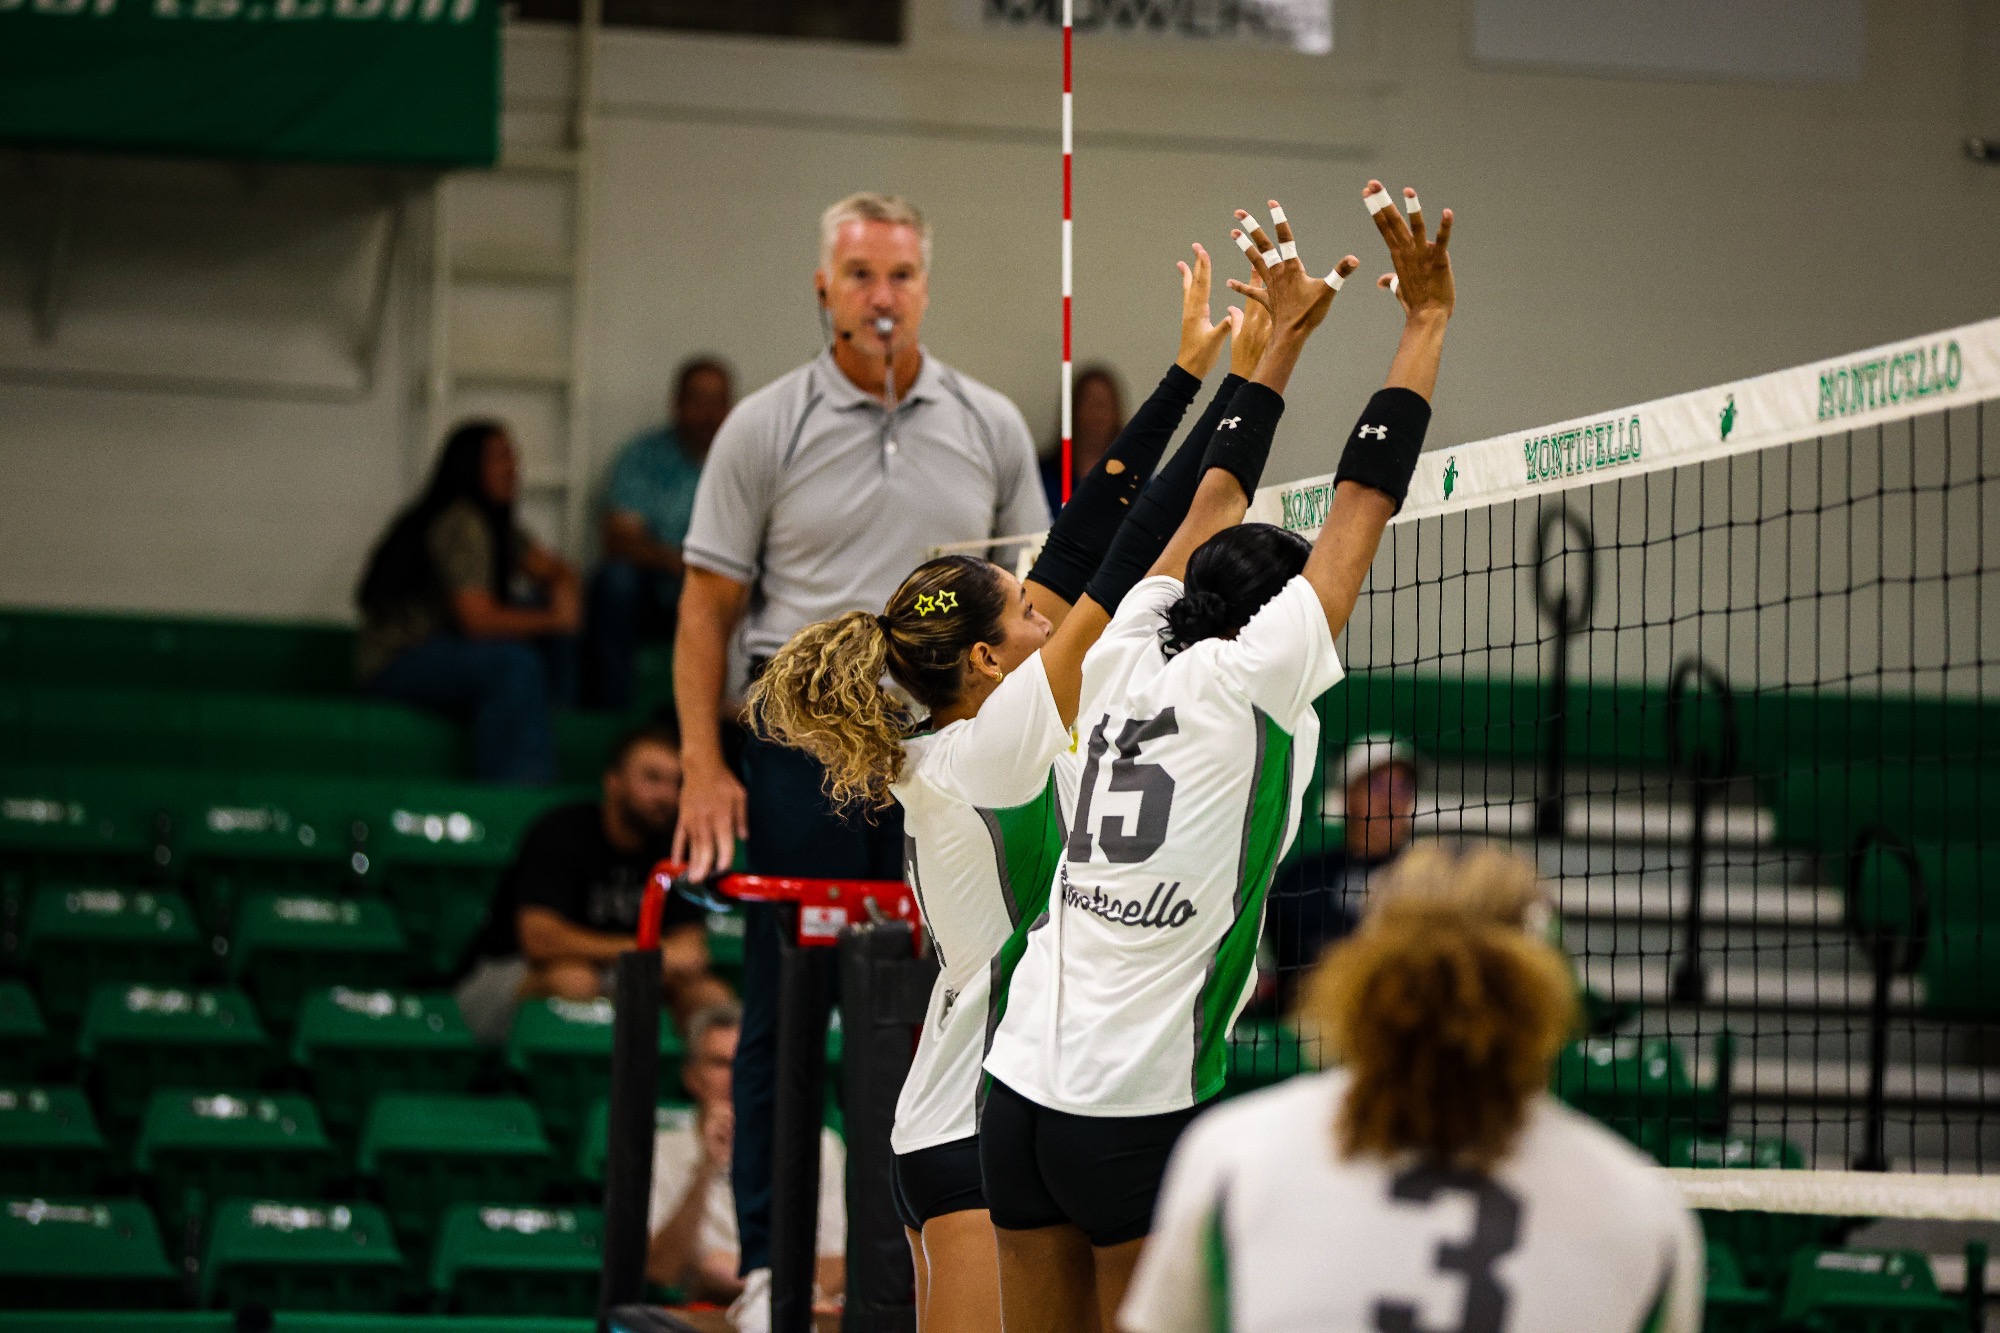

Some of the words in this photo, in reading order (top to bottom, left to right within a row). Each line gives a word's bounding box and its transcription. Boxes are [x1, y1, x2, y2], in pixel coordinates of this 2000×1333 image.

[1818, 339, 1962, 421] MONTICELLO
[1524, 414, 1641, 484] MONTICELLO
[1067, 706, 1179, 863] 15
[1370, 1160, 1524, 1333] 3
